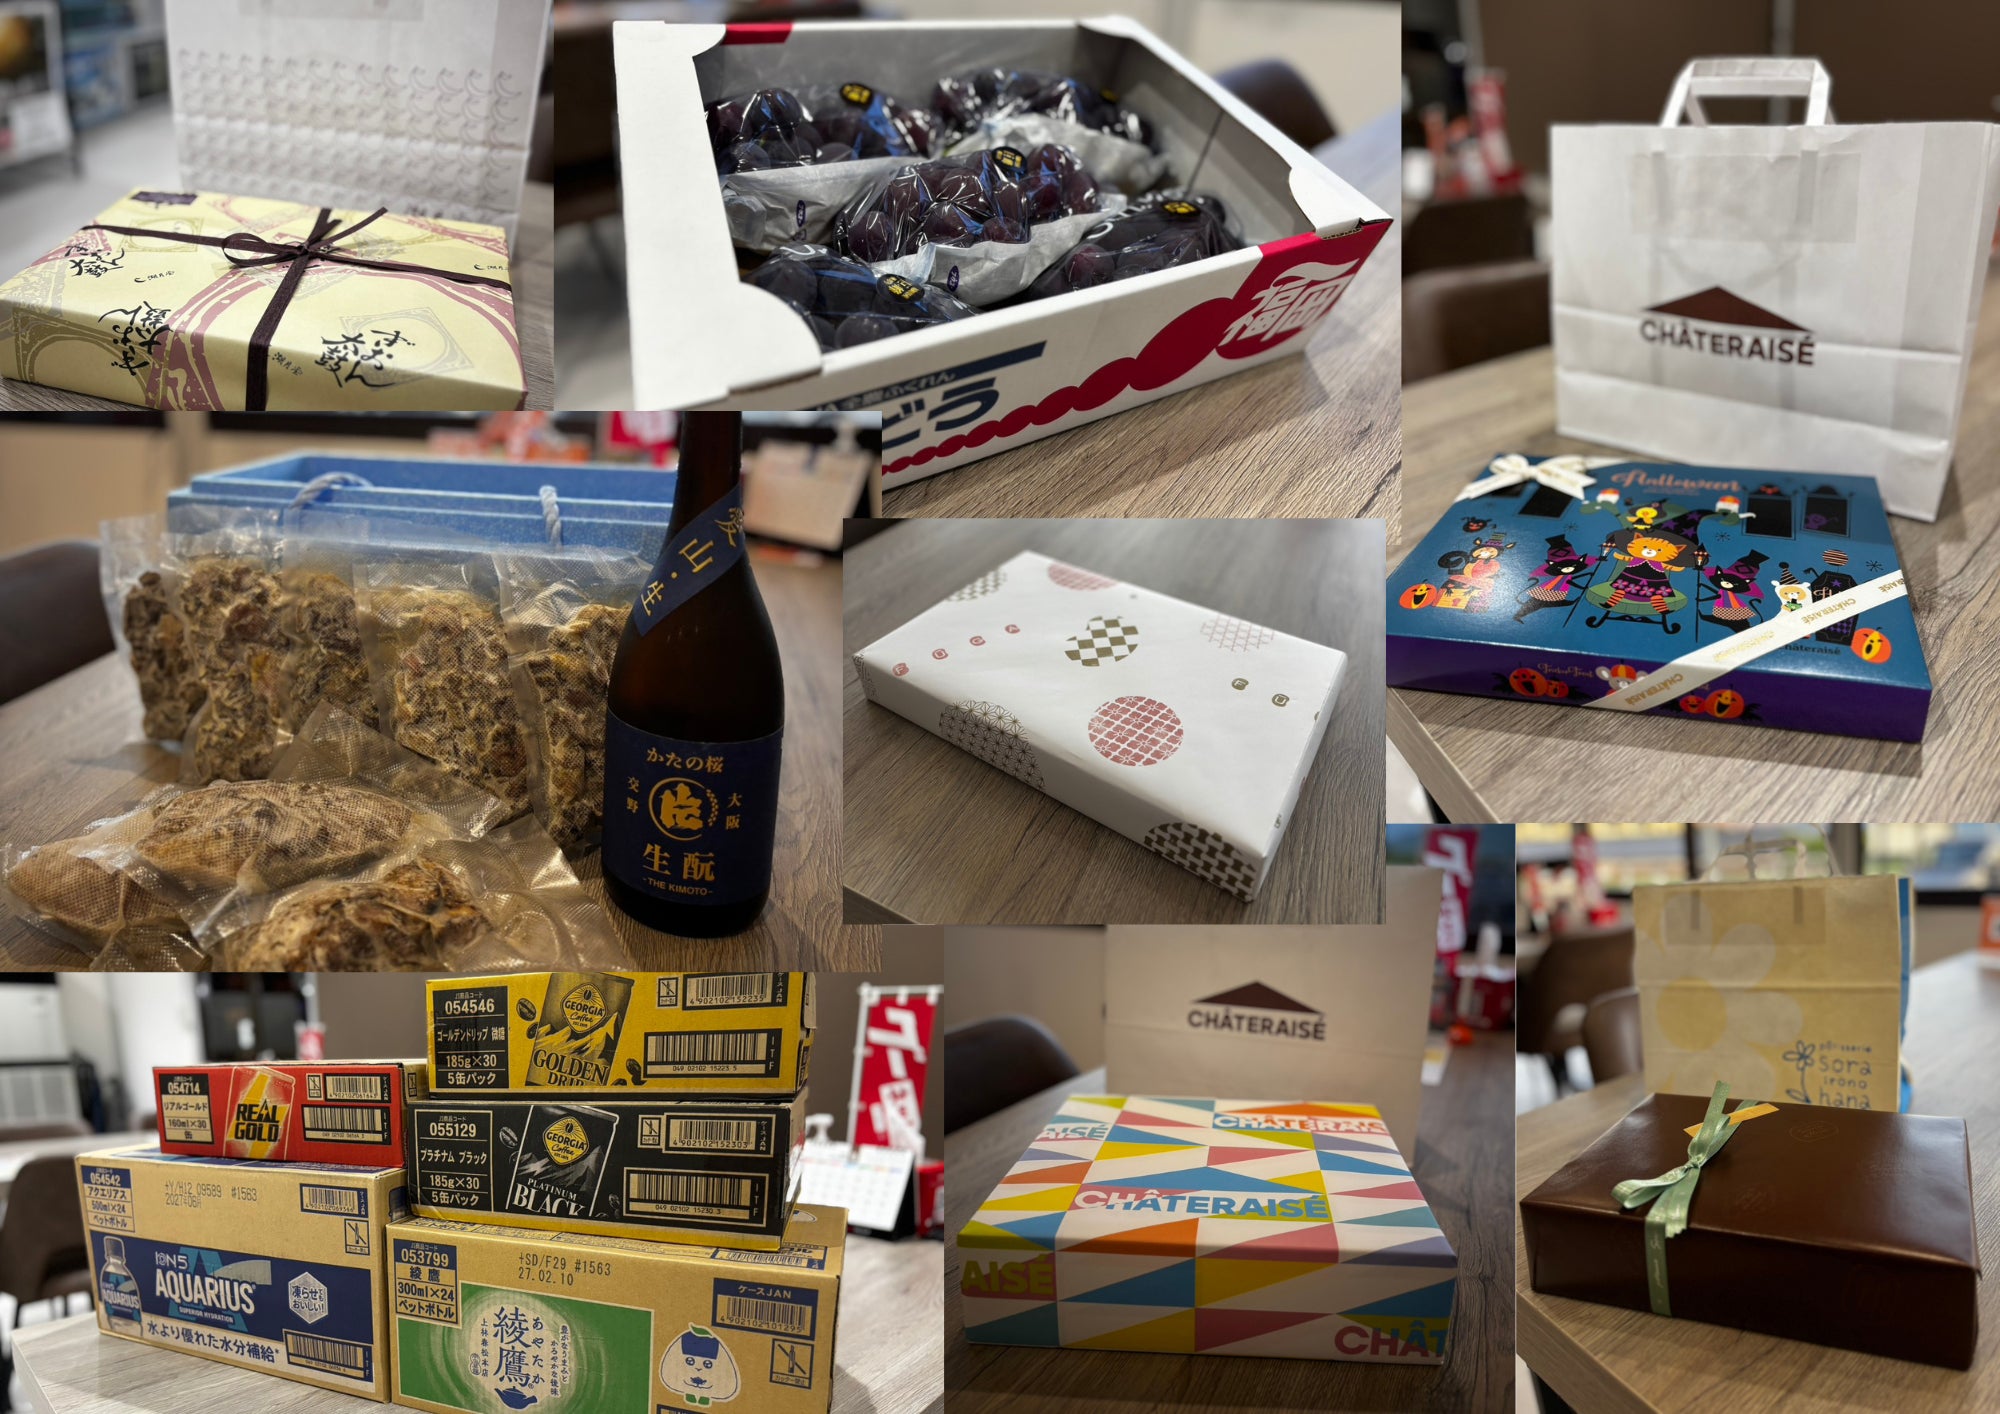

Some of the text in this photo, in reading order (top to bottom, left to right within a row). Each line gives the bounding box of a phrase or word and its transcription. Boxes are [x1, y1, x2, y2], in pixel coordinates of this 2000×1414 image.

[1215, 258, 1360, 342] 福岡
[1640, 321, 1815, 366] CHÂTERAISÉ
[1611, 469, 1741, 492] Halloween
[646, 747, 724, 773] かたの桜
[626, 776, 640, 814] 交野
[725, 792, 743, 830] 大阪
[642, 843, 716, 882] 生酛
[445, 998, 495, 1015] 054546
[564, 1000, 605, 1016] GEORGIA
[570, 1012, 593, 1023] Coffee
[1187, 1005, 1327, 1041] CHÂTERAISÉ
[437, 1027, 489, 1042] ゴールデンドリップ
[446, 1054, 497, 1068] 185g×30
[533, 1049, 609, 1086] GOLDEN
[168, 1082, 201, 1094] 054714
[447, 1072, 496, 1085] 5缶パック
[164, 1102, 208, 1112] リアルゴールド
[1819, 1087, 1872, 1111] hana
[236, 1098, 279, 1123] REAL
[234, 1122, 279, 1142] GOLD
[429, 1122, 476, 1137] 055129
[546, 1132, 585, 1151] GEORGIA
[552, 1144, 575, 1156] Coffee
[420, 1148, 487, 1165] プラチナム ブラック
[90, 1172, 121, 1187] 054542
[430, 1174, 479, 1189] 185g×30
[527, 1177, 577, 1201] PLATINUM
[88, 1186, 127, 1199] アクエリアス
[431, 1191, 479, 1206] 5缶パック
[512, 1183, 586, 1216] BLACK
[1074, 1188, 1330, 1220] CHÂTERAISÉ
[93, 1214, 127, 1228] ペットボトル
[401, 1248, 449, 1267] 053799
[409, 1265, 441, 1283] 綾鷹
[518, 1267, 574, 1286] 27.02.10
[574, 1259, 611, 1276] #1563
[962, 1253, 1054, 1296] AISÉ
[102, 1290, 140, 1310] AQUARIUS
[155, 1268, 256, 1315] AQUARIUS
[397, 1281, 455, 1302] 300ml×24
[737, 1284, 792, 1299] ケースJAN
[178, 1306, 234, 1324] SUPERIOR HYDRATION
[398, 1301, 455, 1320] ペットボトル
[480, 1317, 489, 1378] 上林春松本店
[492, 1305, 532, 1387] 綾鷹
[531, 1316, 545, 1385] あやたか
